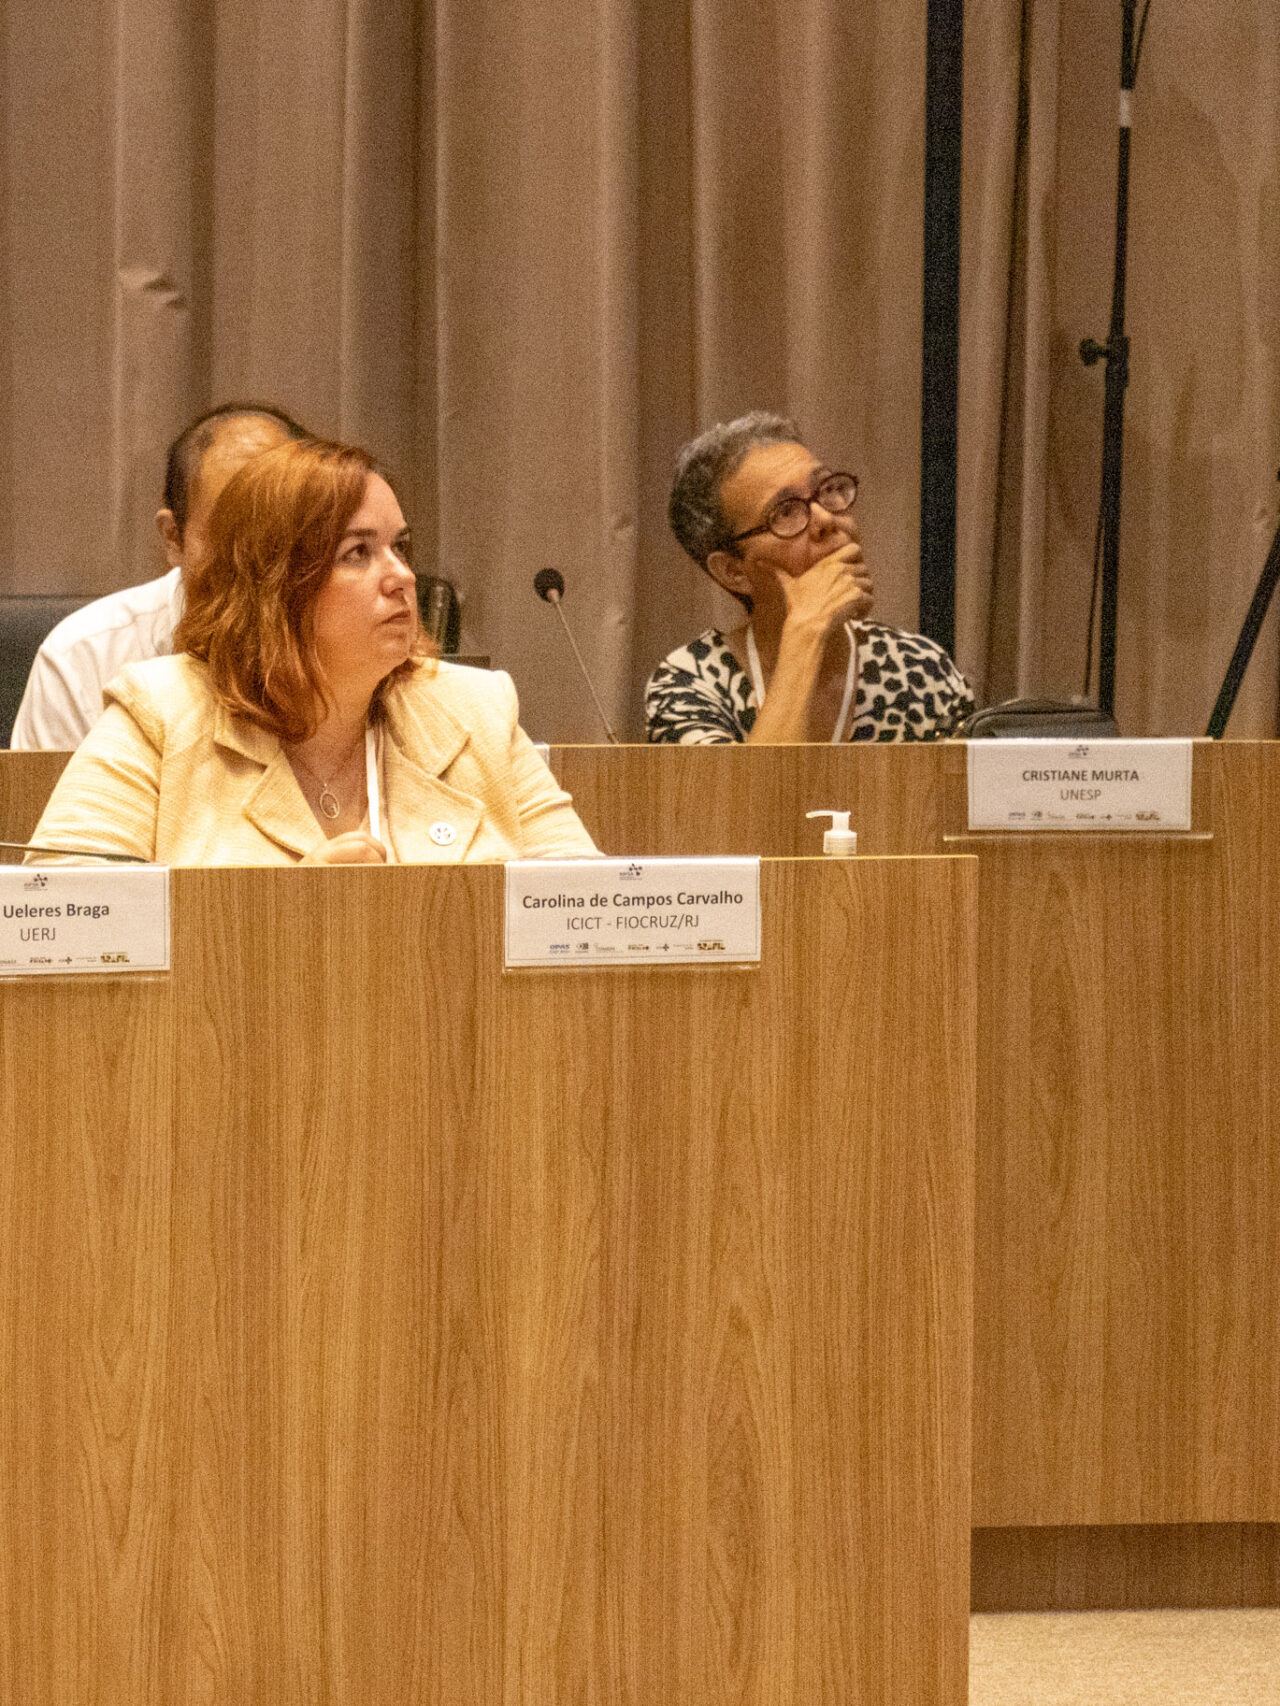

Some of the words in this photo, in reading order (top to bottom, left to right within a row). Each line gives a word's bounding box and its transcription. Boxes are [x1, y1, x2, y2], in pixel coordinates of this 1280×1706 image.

[1022, 769, 1088, 782] CRISTIANE
[1092, 769, 1139, 781] MURTA
[1060, 789, 1102, 801] UNESP
[522, 894, 585, 909] Carolina
[590, 893, 609, 907] de
[612, 893, 673, 909] Campos
[677, 890, 744, 906] Carvalho
[3, 904, 62, 918] Ueleres
[66, 903, 110, 920] Braga
[566, 916, 603, 930] ICICT
[616, 914, 700, 930] FIOCRUZ/RJ
[20, 927, 56, 942] UERJ
